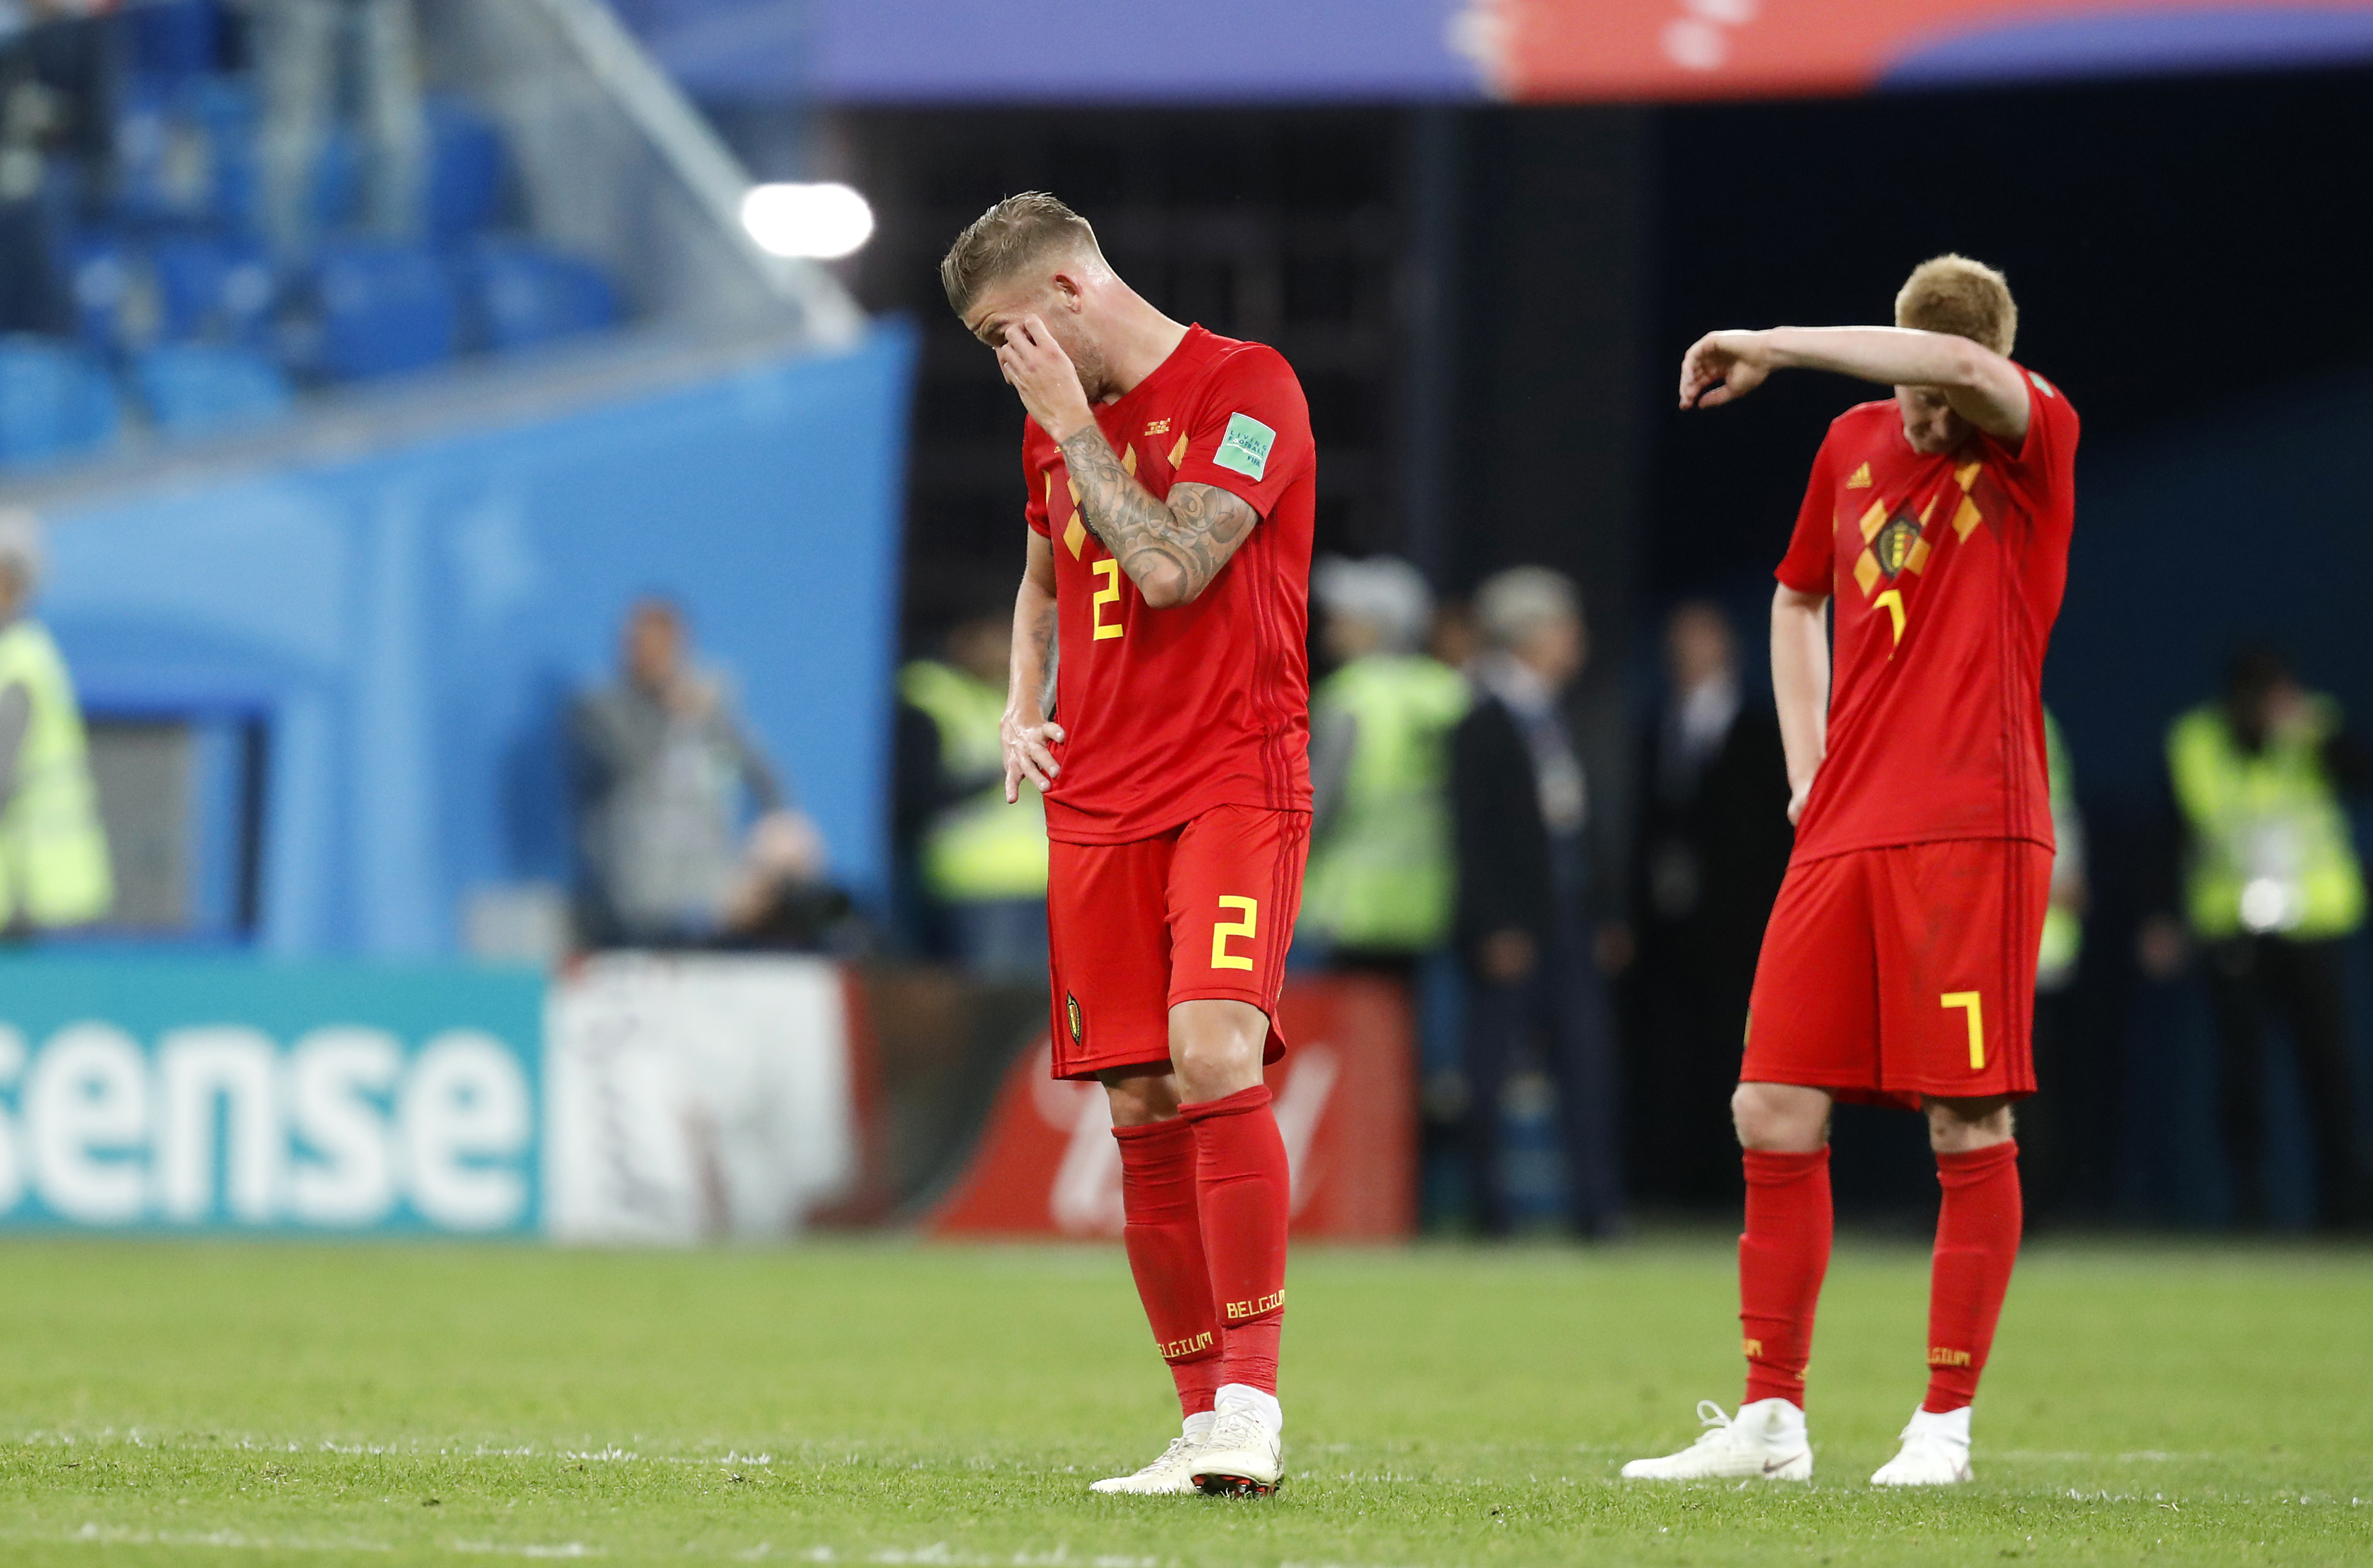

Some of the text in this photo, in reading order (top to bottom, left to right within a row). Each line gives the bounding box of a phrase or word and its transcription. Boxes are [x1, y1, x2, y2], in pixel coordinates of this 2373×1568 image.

[1230, 430, 1267, 451] LIVING
[1247, 455, 1260, 468] FIFA
[1092, 558, 1124, 641] 2
[1873, 589, 1906, 660] 7
[1211, 895, 1257, 971] 2
[1941, 991, 1985, 1069] 7
[0, 1024, 530, 1228] ense
[1226, 1289, 1285, 1319] BELGIUM
